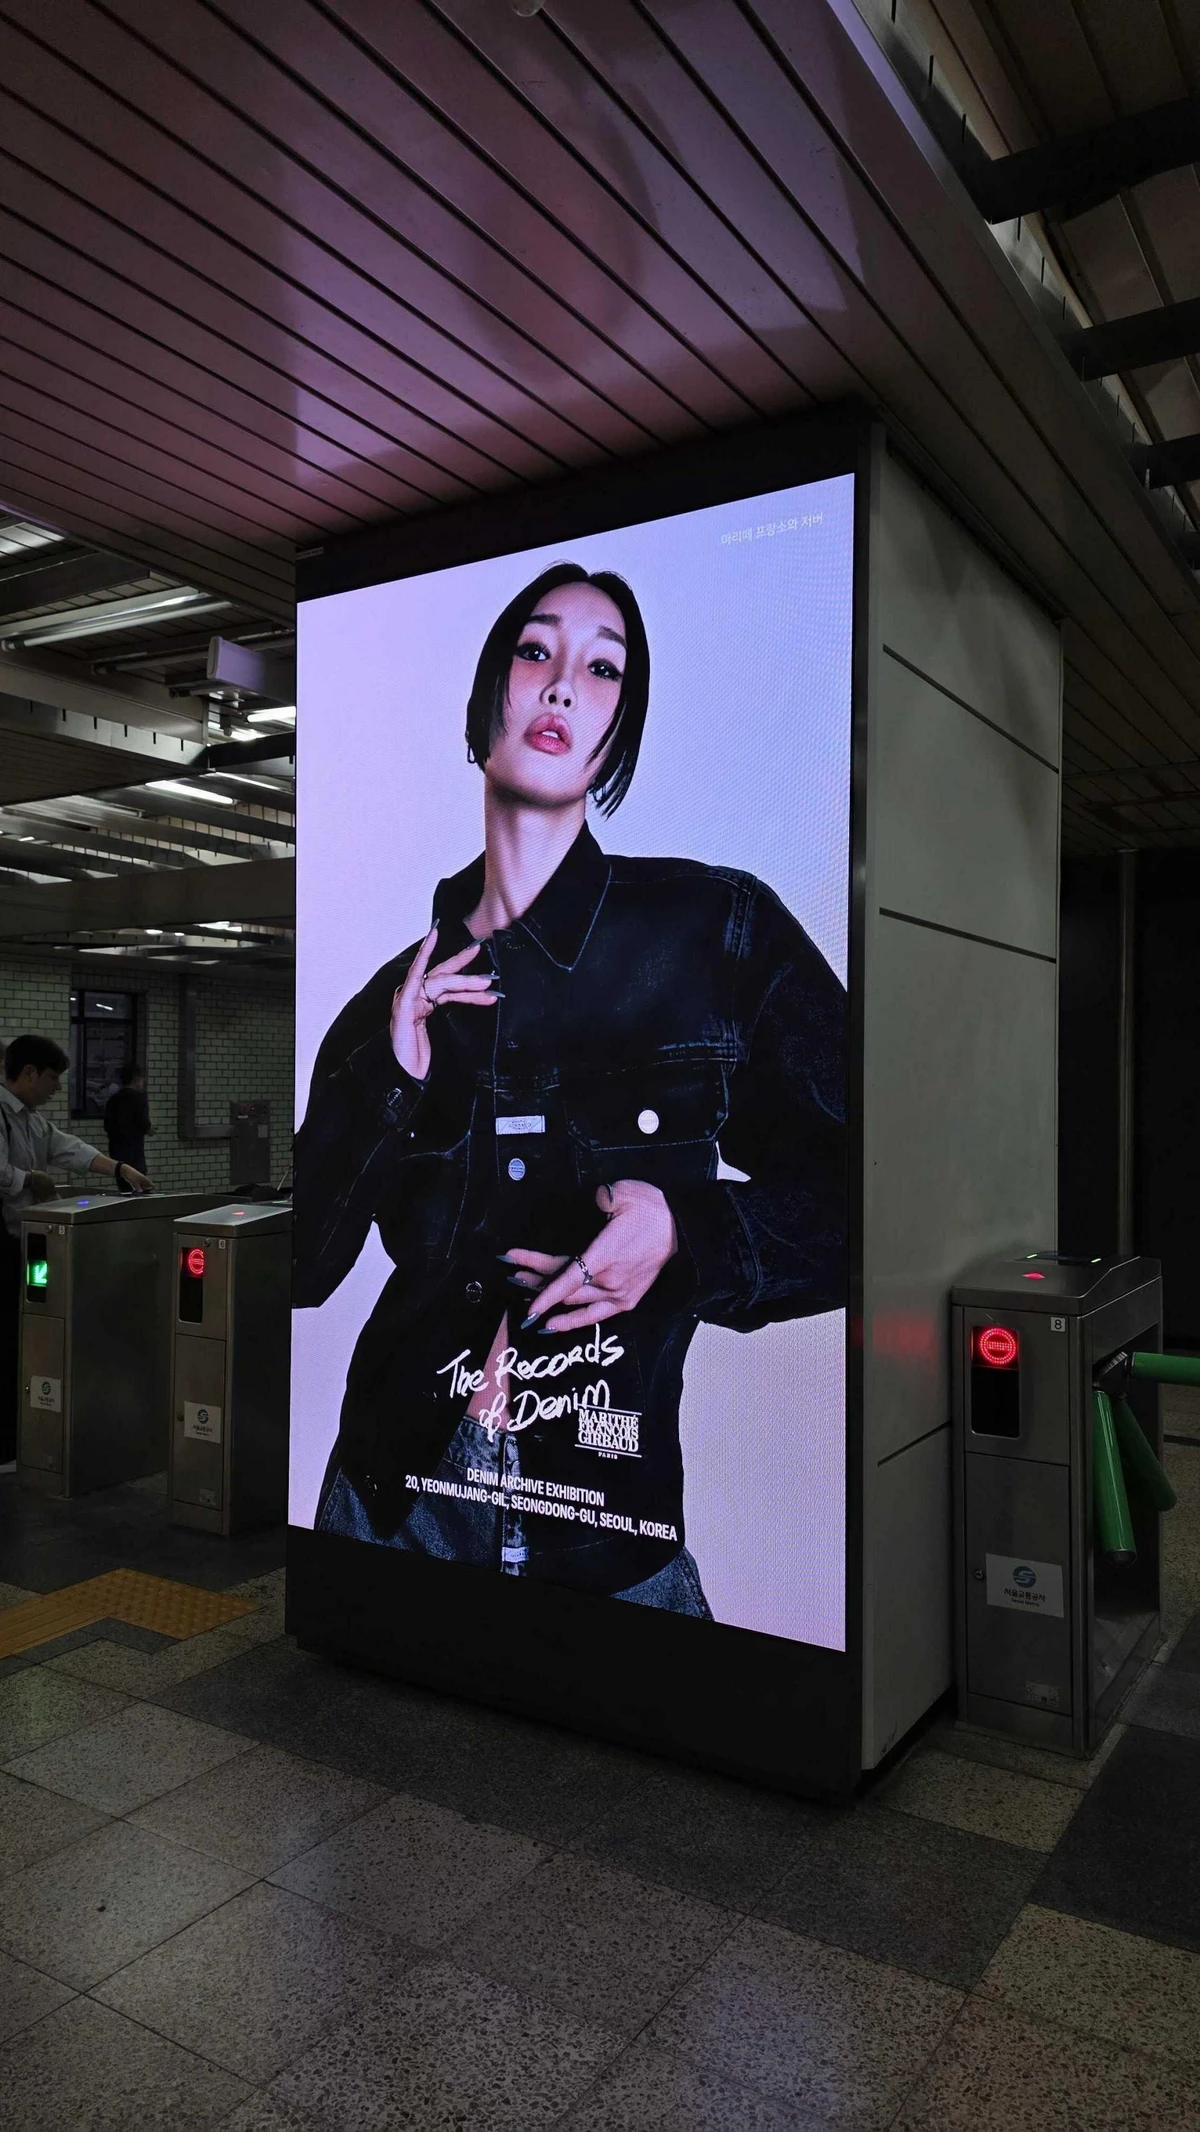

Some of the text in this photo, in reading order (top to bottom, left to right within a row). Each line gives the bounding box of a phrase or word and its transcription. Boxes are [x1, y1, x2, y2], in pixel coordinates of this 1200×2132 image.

[756, 517, 798, 538] 프랑소와
[801, 511, 824, 528] 저버
[436, 1323, 625, 1399] The Records
[478, 1395, 507, 1443] of
[578, 1430, 639, 1453] GIRBAUD
[598, 1451, 618, 1460] PARIS
[466, 1467, 605, 1507] DENIM ARCHIVE EXHIBITION
[405, 1474, 678, 1542] 20, YEONMUJANG-GIL, SEONGDONG-GU, SEOUL, KOREA
